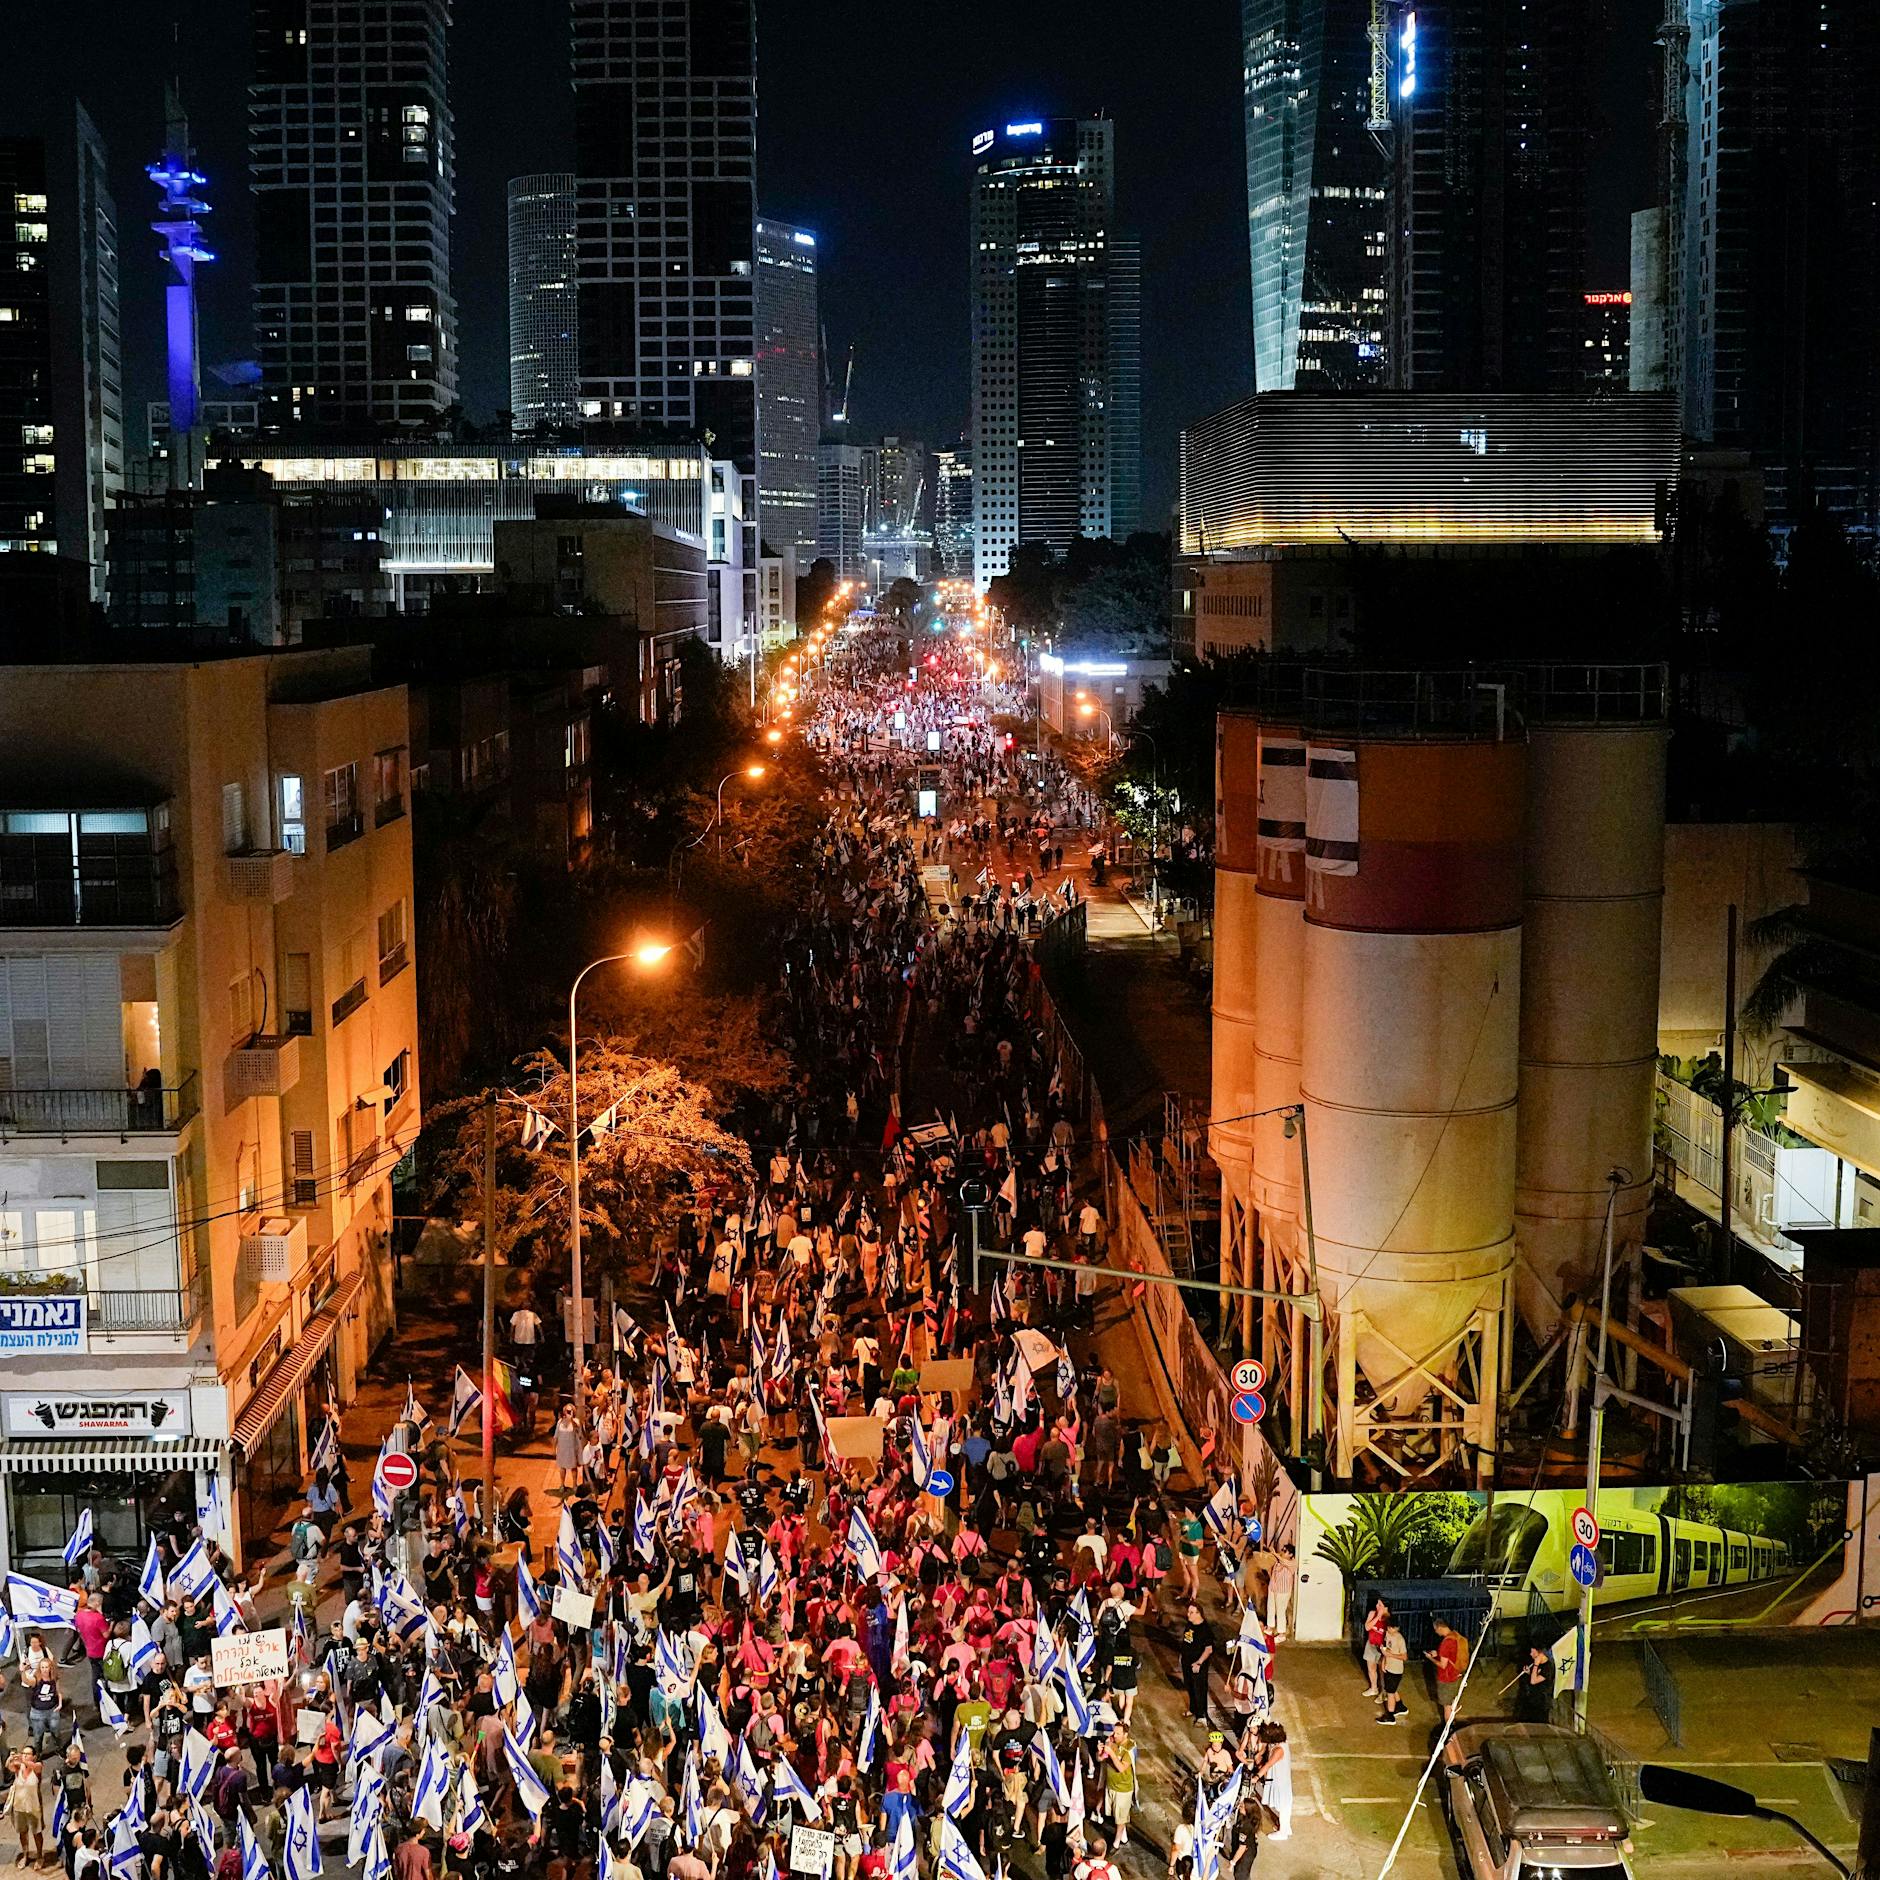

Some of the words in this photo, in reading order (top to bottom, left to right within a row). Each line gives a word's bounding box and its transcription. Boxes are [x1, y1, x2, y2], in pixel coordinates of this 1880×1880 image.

[37, 1331, 79, 1346] למגילת
[1240, 1369, 1257, 1384] 30
[55, 1402, 148, 1418] המפגש
[1578, 1519, 1593, 1539] 30
[239, 1635, 250, 1644] לנו
[255, 1634, 265, 1644] יש
[216, 1646, 249, 1661] נהדרת
[255, 1640, 279, 1653] ארץ
[240, 1656, 260, 1668] אבל
[255, 1665, 284, 1677] ממשלה
